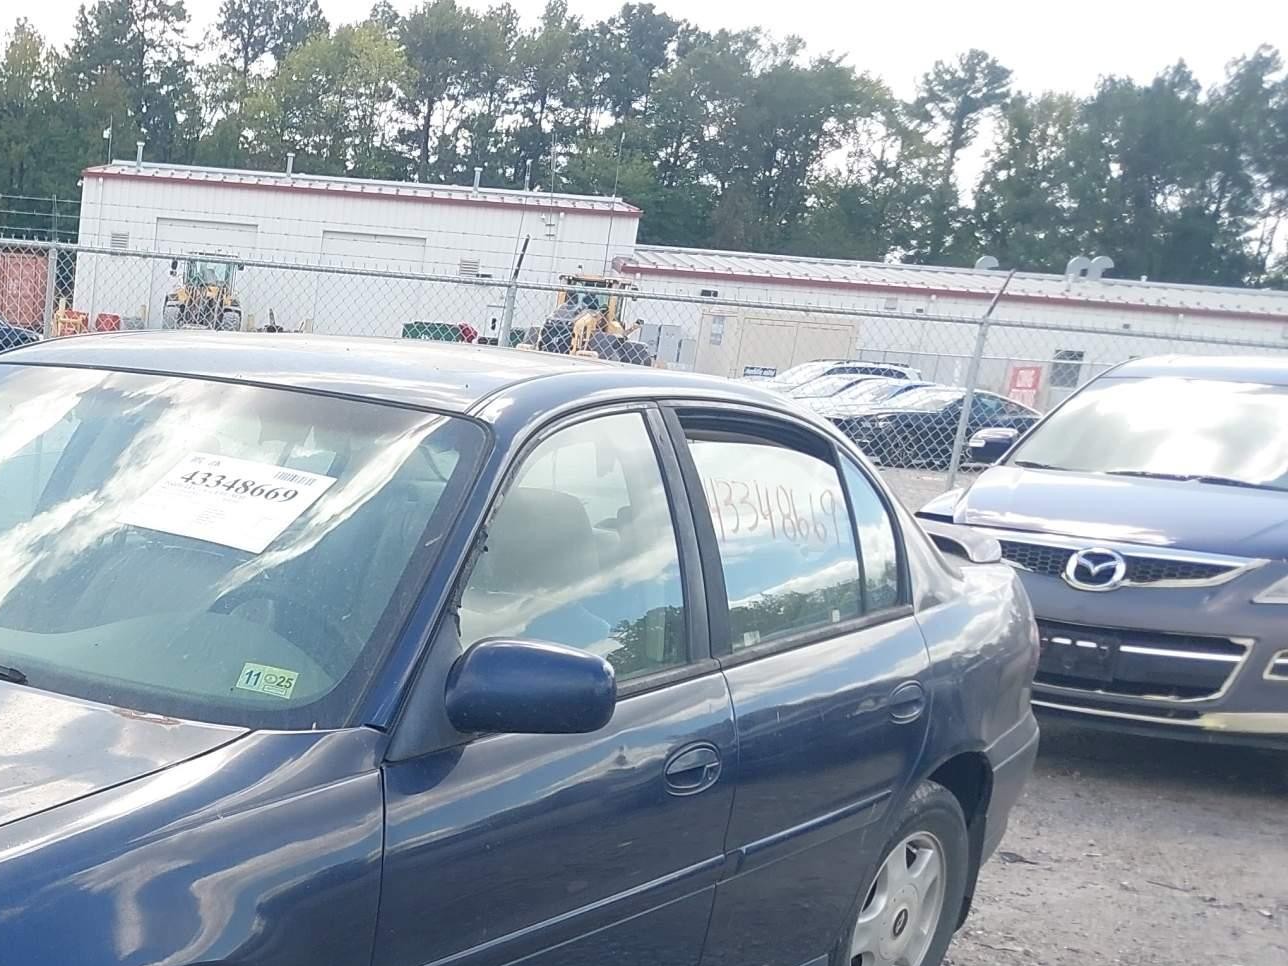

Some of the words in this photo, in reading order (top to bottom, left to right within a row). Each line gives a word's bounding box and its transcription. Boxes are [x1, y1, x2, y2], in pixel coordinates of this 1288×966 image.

[181, 470, 298, 502] 43348669
[704, 478, 839, 544] 43348669
[246, 670, 261, 686] 11
[277, 675, 294, 688] 25
